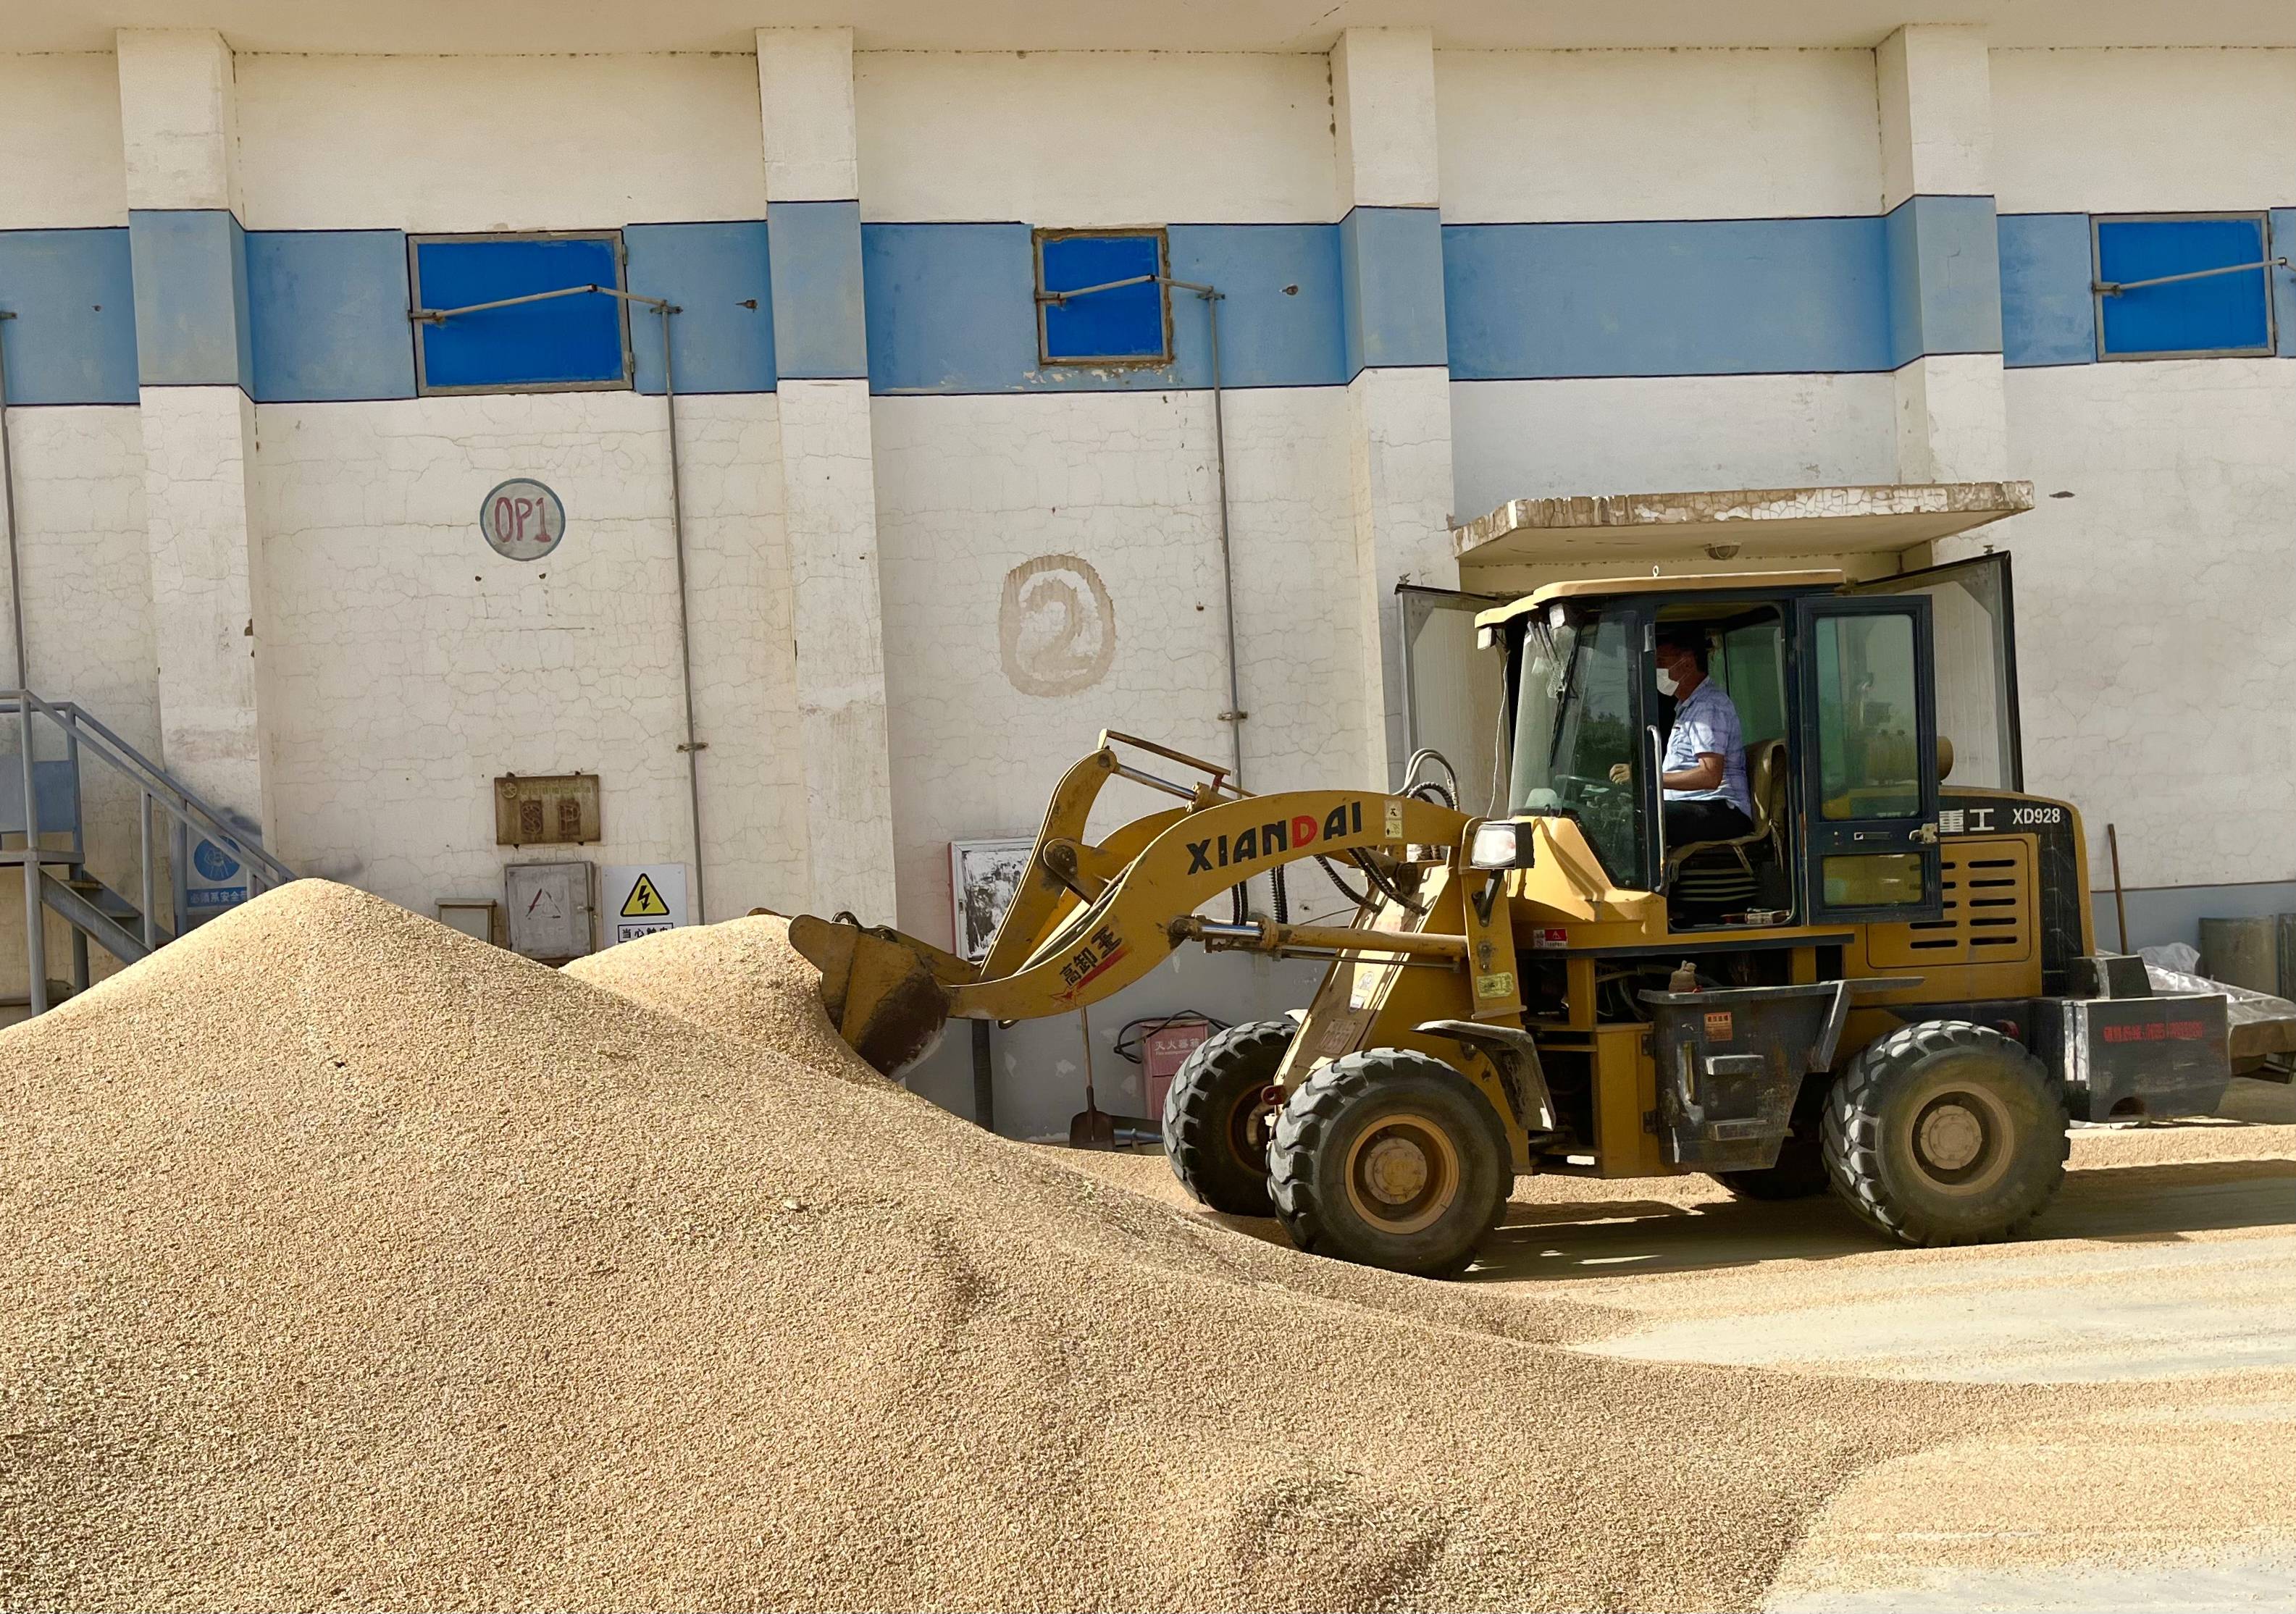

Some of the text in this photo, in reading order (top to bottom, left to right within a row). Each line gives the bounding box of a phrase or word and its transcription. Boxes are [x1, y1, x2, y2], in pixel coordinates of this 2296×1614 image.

[1021, 577, 1092, 673] 2
[1186, 801, 1362, 875] XIANDAI
[1938, 808, 1995, 833] 重工
[2012, 807, 2061, 825] XD928
